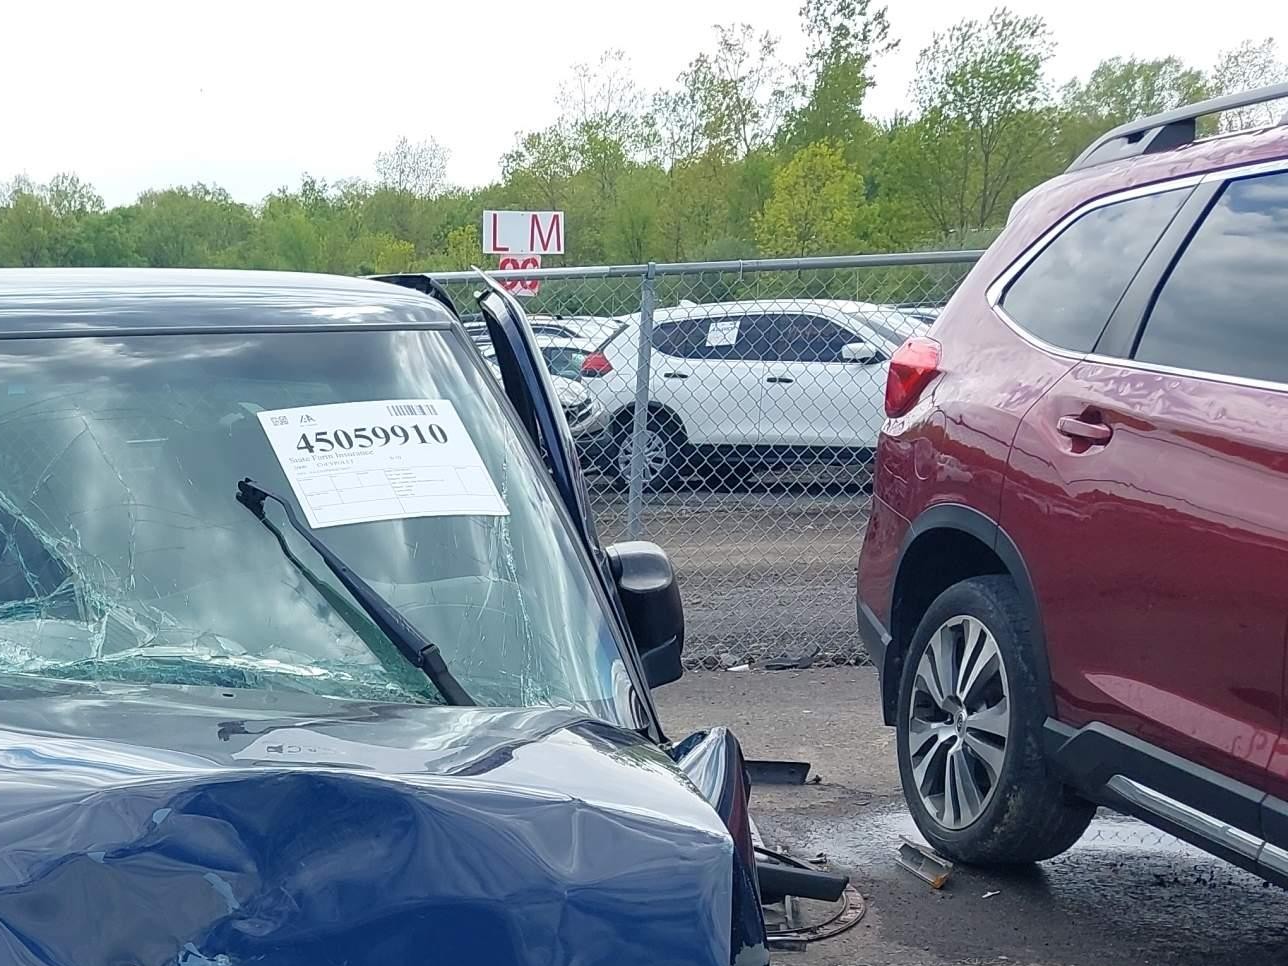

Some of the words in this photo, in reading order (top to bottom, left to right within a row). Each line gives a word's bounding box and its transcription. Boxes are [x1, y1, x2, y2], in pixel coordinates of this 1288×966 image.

[492, 213, 509, 252] L
[530, 213, 561, 252] M
[296, 424, 448, 454] 45059910
